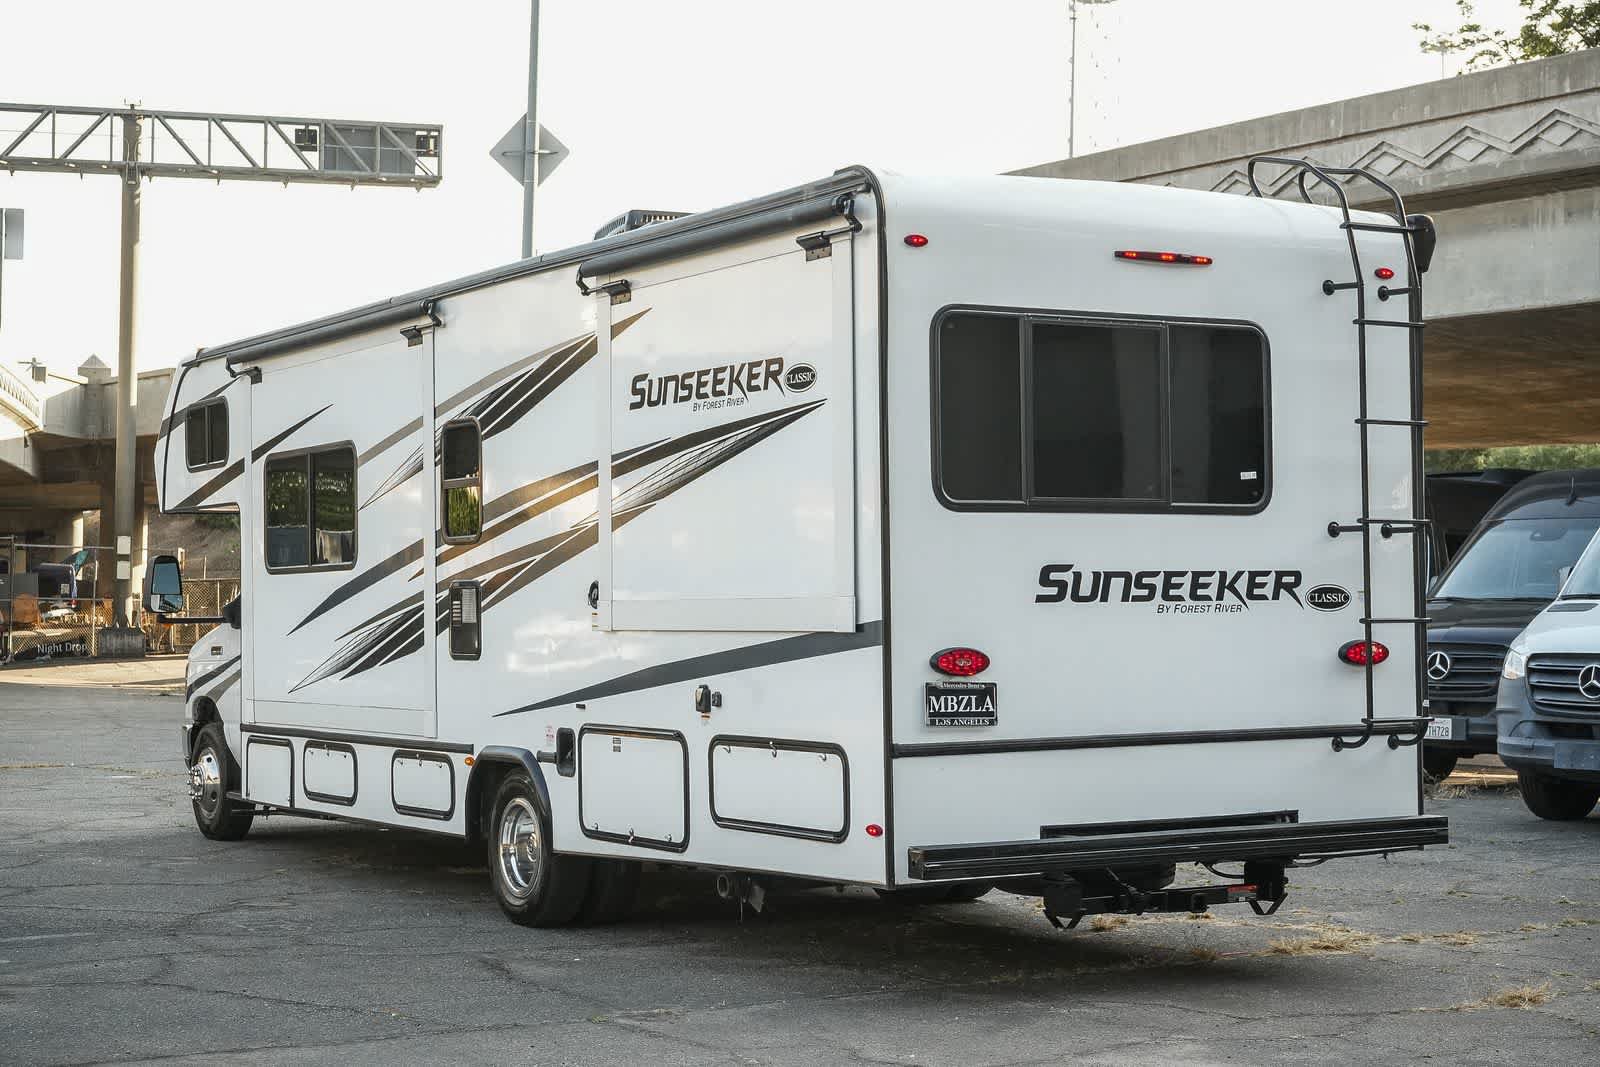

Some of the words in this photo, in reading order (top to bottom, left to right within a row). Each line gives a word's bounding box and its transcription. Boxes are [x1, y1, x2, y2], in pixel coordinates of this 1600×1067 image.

[629, 357, 785, 410] SUNSEEKER
[785, 369, 816, 385] CLASSIC
[693, 402, 701, 412] BY
[702, 400, 725, 410] FOREST
[726, 397, 744, 407] RIVER
[1035, 564, 1304, 609] SUNSEEKER
[1308, 592, 1350, 603] CLASSIC
[1157, 603, 1171, 614] BY
[1173, 603, 1212, 614] FOREST
[1214, 603, 1242, 613] RIVER
[37, 642, 62, 655] Night
[65, 641, 88, 654] Drop
[929, 695, 994, 713] MBZLA
[935, 718, 951, 726] LOS
[952, 718, 990, 726] ANGELES
